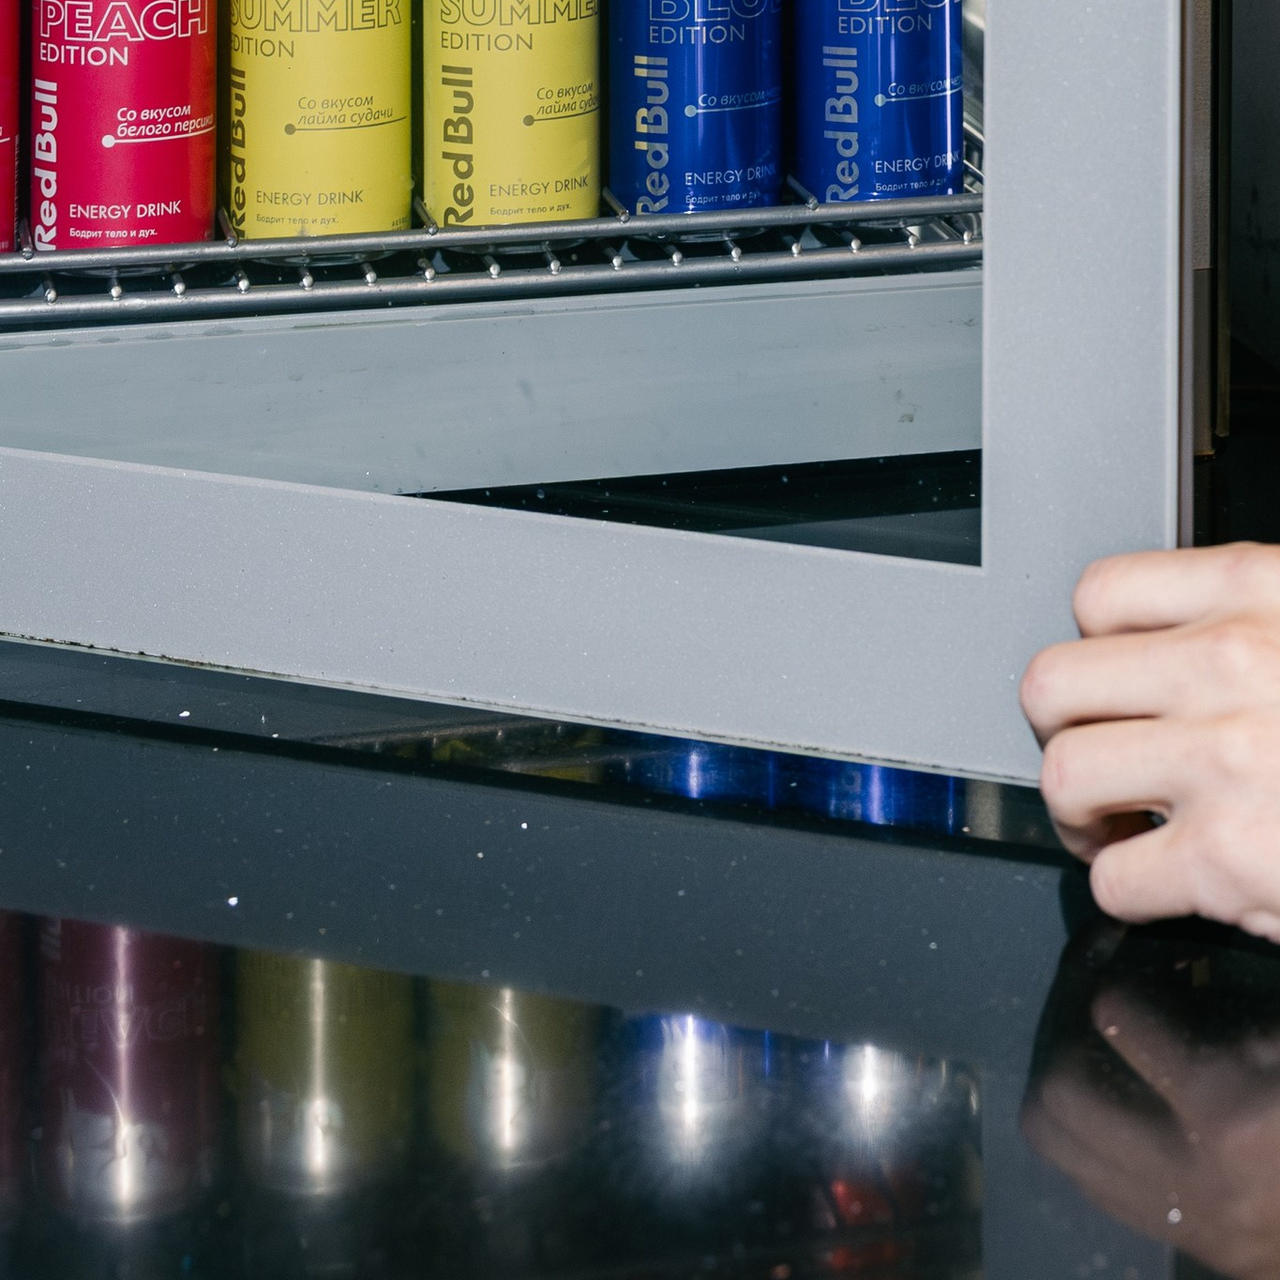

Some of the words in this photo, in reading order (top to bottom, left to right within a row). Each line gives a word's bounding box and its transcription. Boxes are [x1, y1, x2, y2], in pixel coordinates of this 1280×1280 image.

[838, 13, 932, 34] EDITION
[441, 31, 533, 51] EDITION
[650, 24, 745, 44] EDITION
[40, 42, 129, 66] EDITION
[231, 33, 294, 58] DITION
[537, 87, 554, 101] Со
[557, 82, 594, 100] вкусом
[634, 55, 669, 134] Bull
[822, 46, 858, 123] Bull
[888, 82, 906, 96] Со
[231, 67, 247, 148] Bull
[298, 96, 316, 110] Со
[321, 95, 374, 112] вкусом
[442, 65, 474, 145] Bull
[536, 100, 577, 116] лайма
[698, 93, 717, 107] Со
[720, 90, 766, 108] вкусом
[35, 79, 58, 163] Bull
[117, 107, 136, 122] Со
[140, 105, 191, 123] вкусом
[297, 111, 346, 125] лайма
[350, 107, 394, 125] судачи
[117, 122, 171, 137] белого
[684, 169, 743, 186] ENERGY
[747, 163, 777, 180] DRINK
[823, 130, 859, 203] Red
[875, 157, 931, 174] ENERGY
[490, 182, 550, 197] ENERGY
[554, 175, 589, 193] DRINK
[634, 141, 670, 216] Red
[256, 190, 312, 206] ENERGY
[318, 190, 364, 205] DRINK
[442, 151, 475, 228] Red
[685, 194, 719, 205] Бодрит
[34, 167, 58, 251] Red
[69, 204, 131, 219] ENERGY
[136, 200, 181, 217] DRINK
[490, 206, 524, 217] Бодрит
[527, 205, 547, 214] тело
[256, 214, 285, 225] Бодрит
[288, 215, 309, 224] тело
[69, 227, 103, 239] Бодрит
[105, 228, 127, 238] тело
[139, 228, 158, 239] дух.
